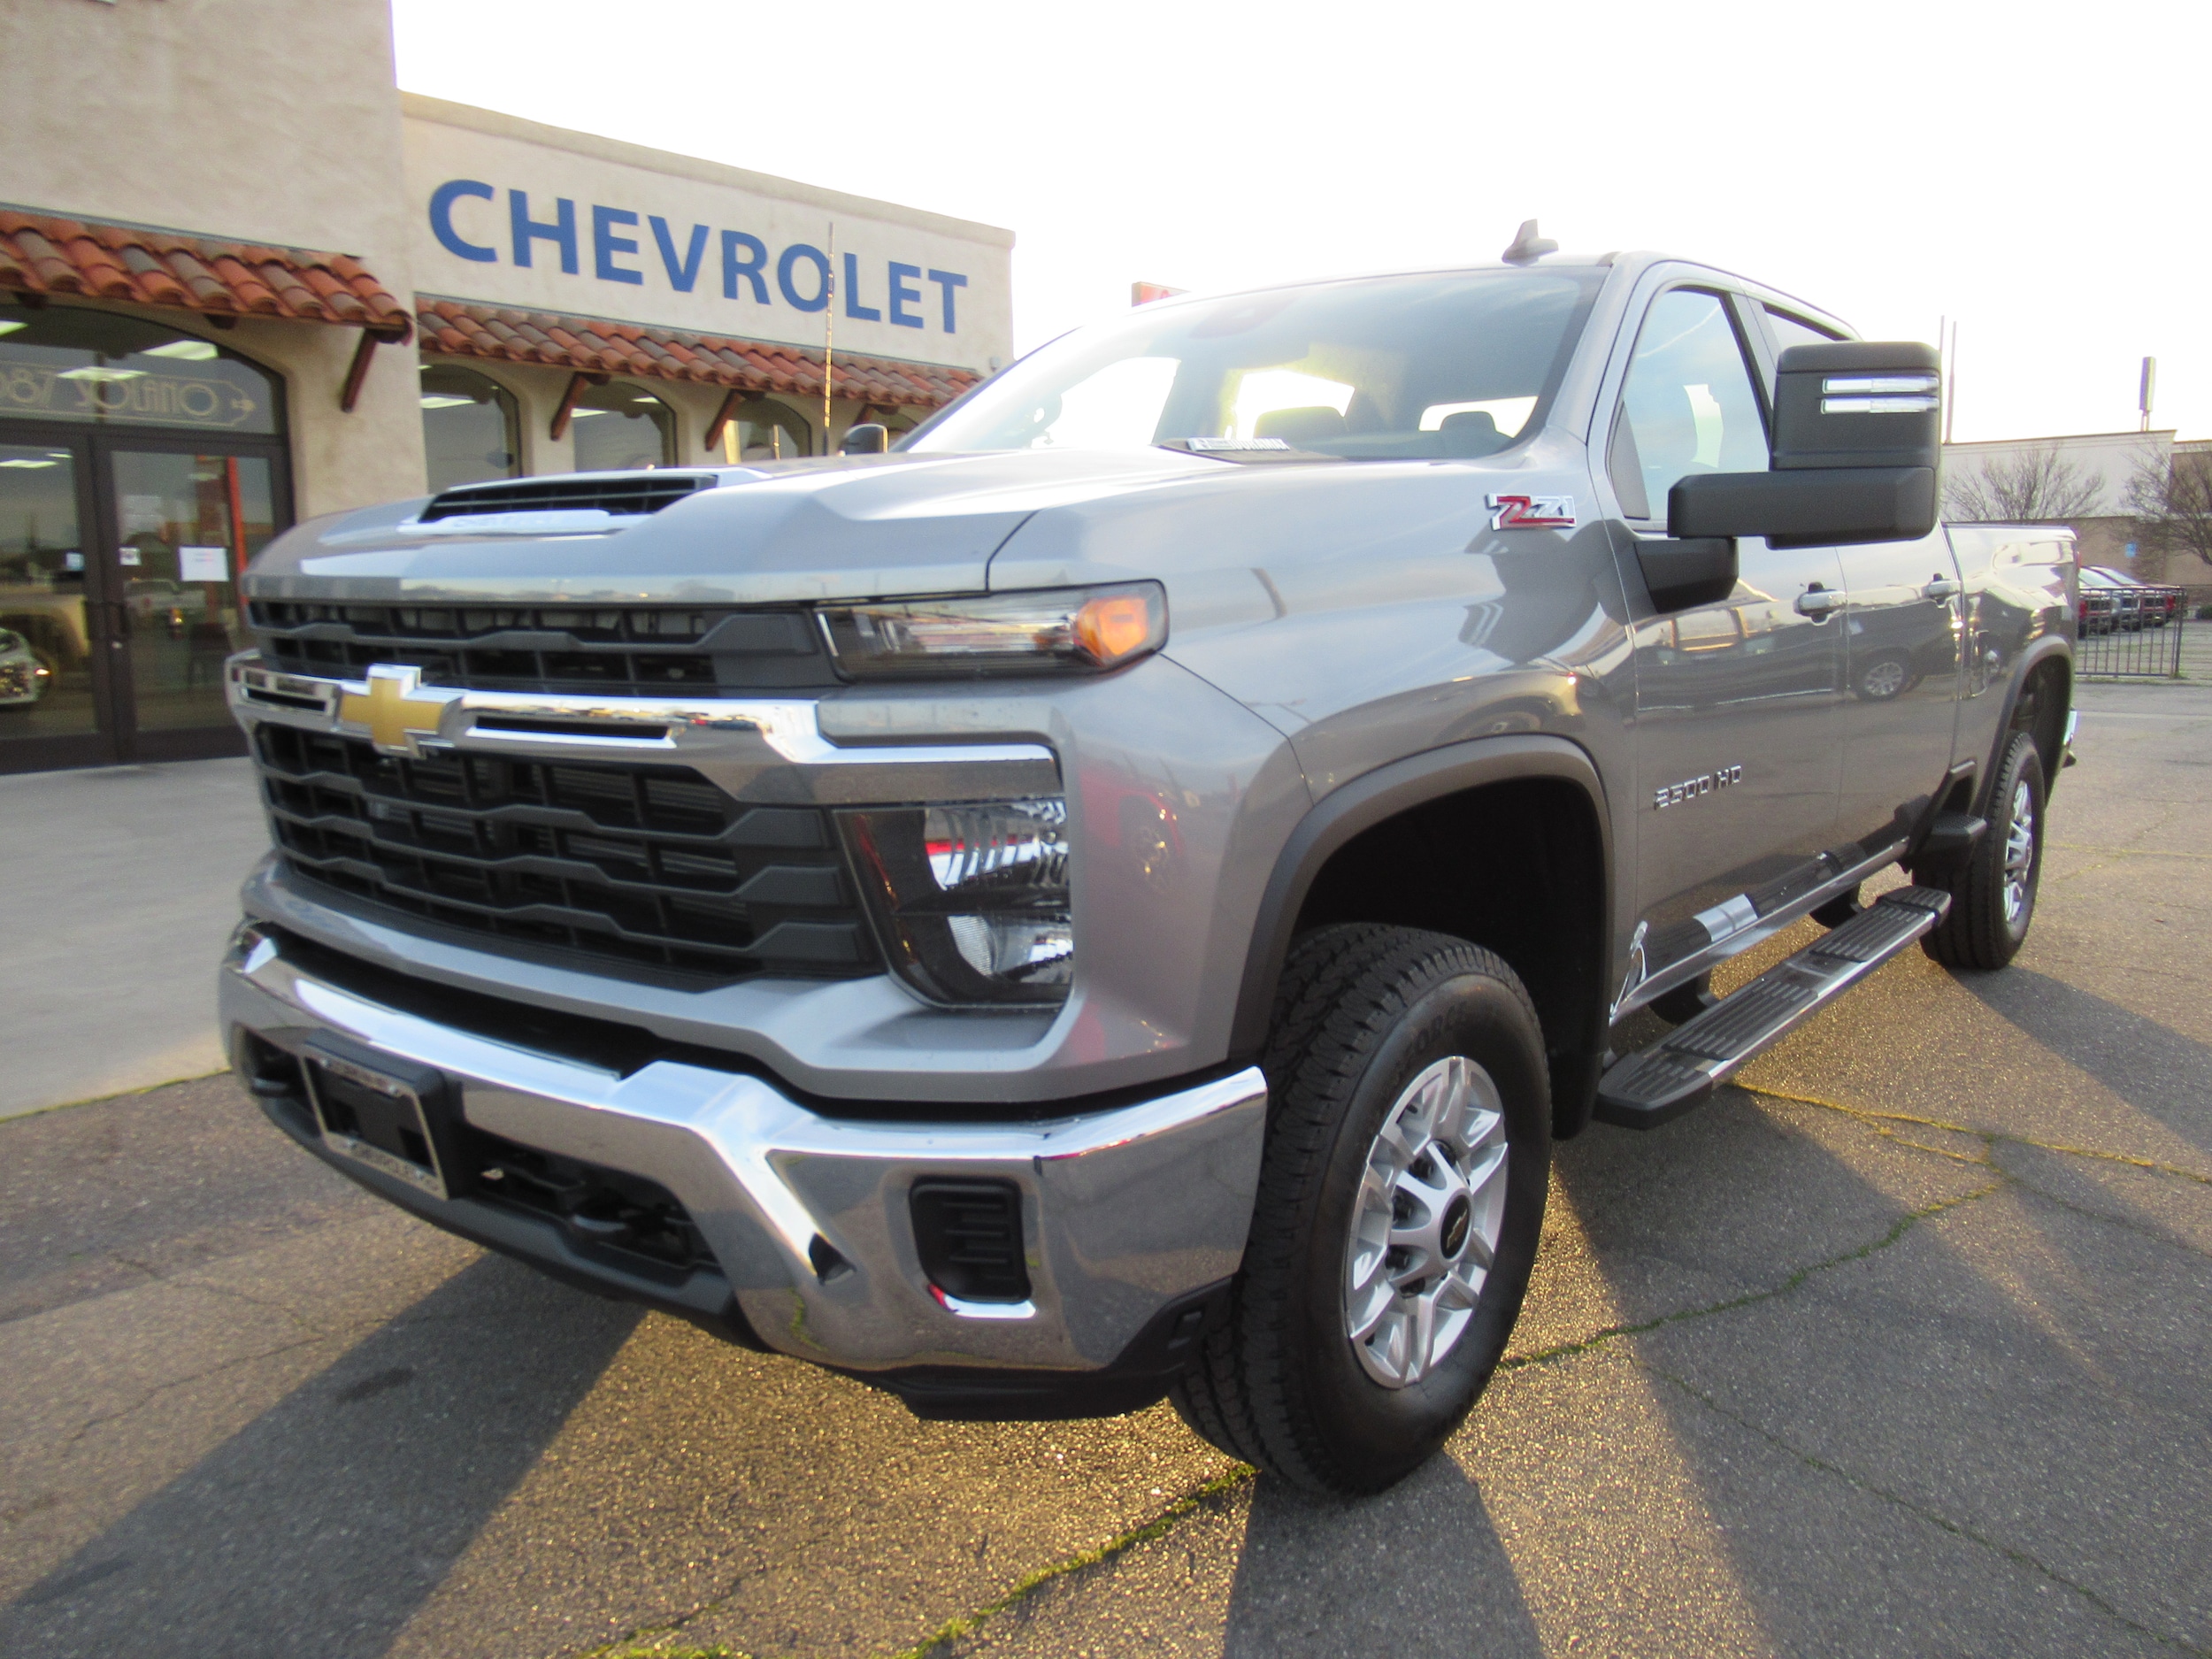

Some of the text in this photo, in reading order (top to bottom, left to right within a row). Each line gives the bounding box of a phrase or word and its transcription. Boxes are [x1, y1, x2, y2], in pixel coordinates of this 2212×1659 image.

[429, 179, 967, 334] CHEVROLET
[1486, 493, 1577, 531] Z71
[1654, 764, 1742, 810] 2500 HD
